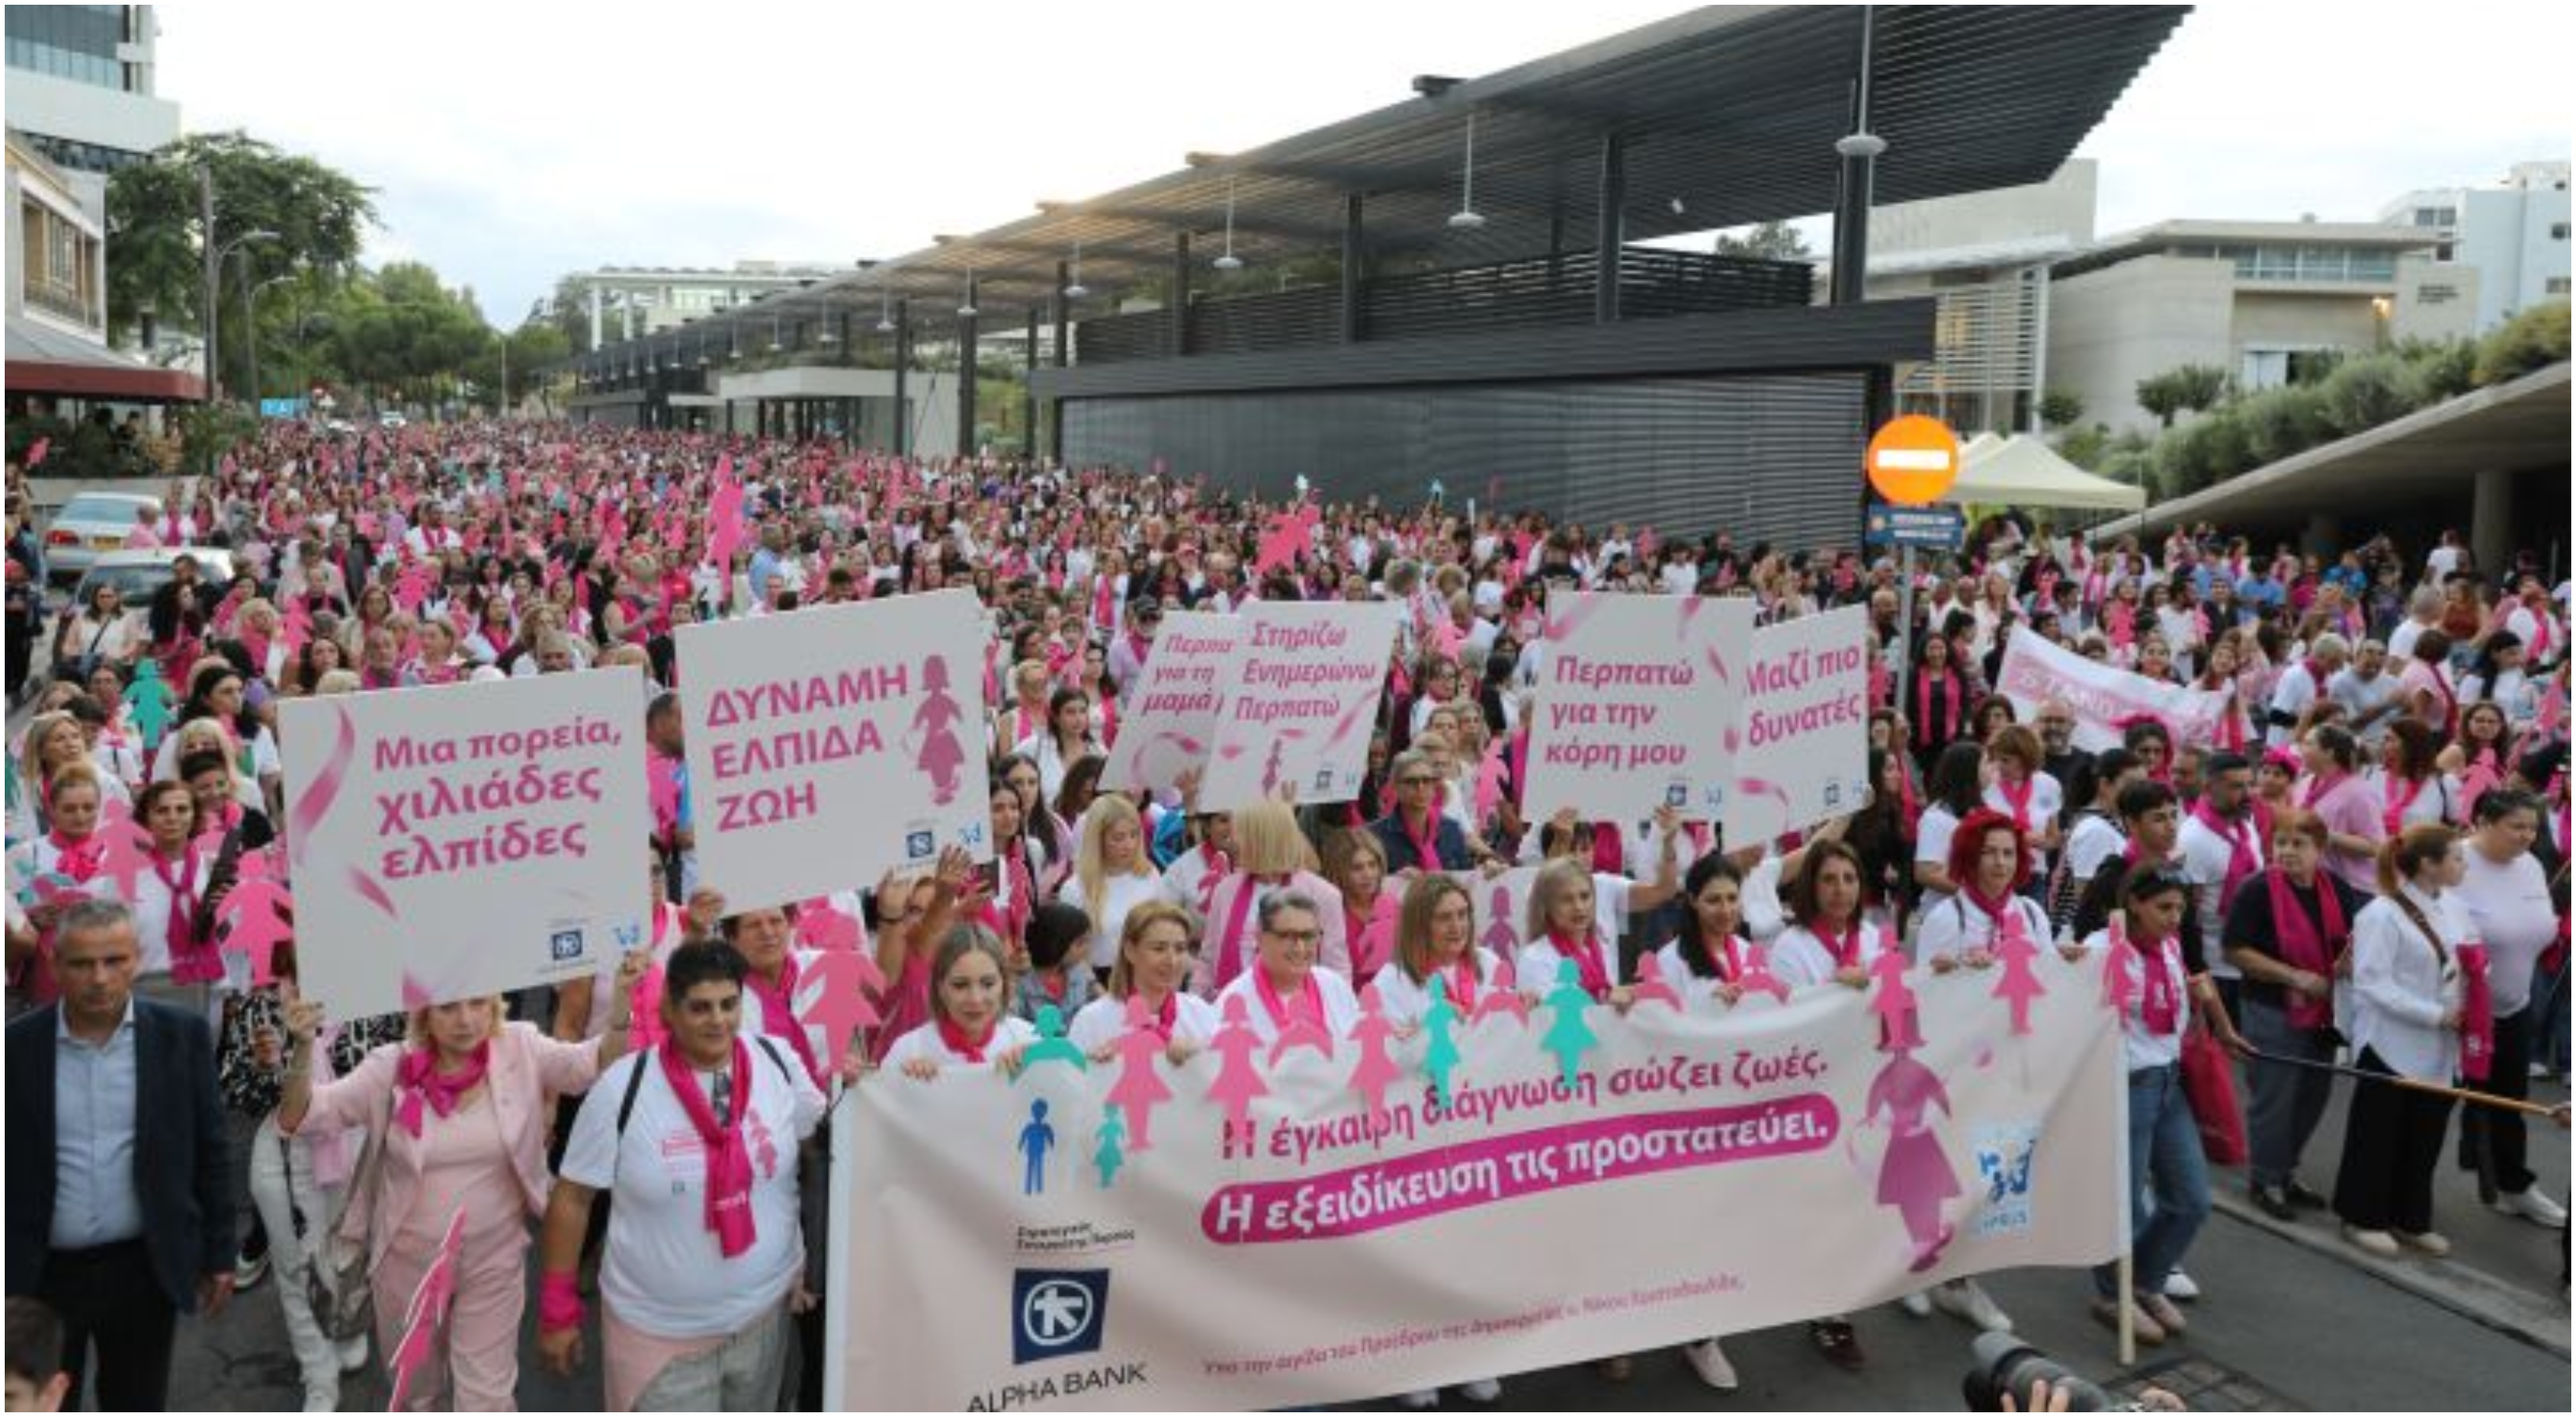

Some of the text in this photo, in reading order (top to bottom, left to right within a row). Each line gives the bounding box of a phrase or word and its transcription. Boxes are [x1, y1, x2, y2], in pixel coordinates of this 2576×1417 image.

[1166, 634, 1234, 656] Περπα
[1252, 620, 1347, 652] Στηρίζω
[1155, 667, 1186, 685] για
[1242, 656, 1377, 690] Ενημερώνω
[1555, 654, 1695, 690] Περπατώ
[1817, 644, 1861, 678] πιο
[706, 662, 908, 727] ΔΥΝΑΜΗ
[1144, 687, 1212, 716] μαμά
[1236, 692, 1341, 723] Περπατώ
[1550, 701, 1658, 731] για την
[1747, 688, 1862, 748] δυνατές
[374, 716, 622, 772] Μια πορεία,
[712, 719, 884, 780] ΕΛΠΙΔΑ
[1545, 735, 1688, 771] κόρη μου
[376, 763, 603, 836] χιλιάδες
[717, 780, 818, 832] ΖΩΗ
[382, 820, 587, 880] ελπίδες
[1269, 1103, 1415, 1167] έγκαιρη
[1608, 1056, 1721, 1095] σώζει
[1732, 1045, 1829, 1090] ζωές.
[1216, 1106, 1829, 1234] Η εξειδίκευση τις προστατεύει.
[966, 1361, 1147, 1412] ALPHA BANK
